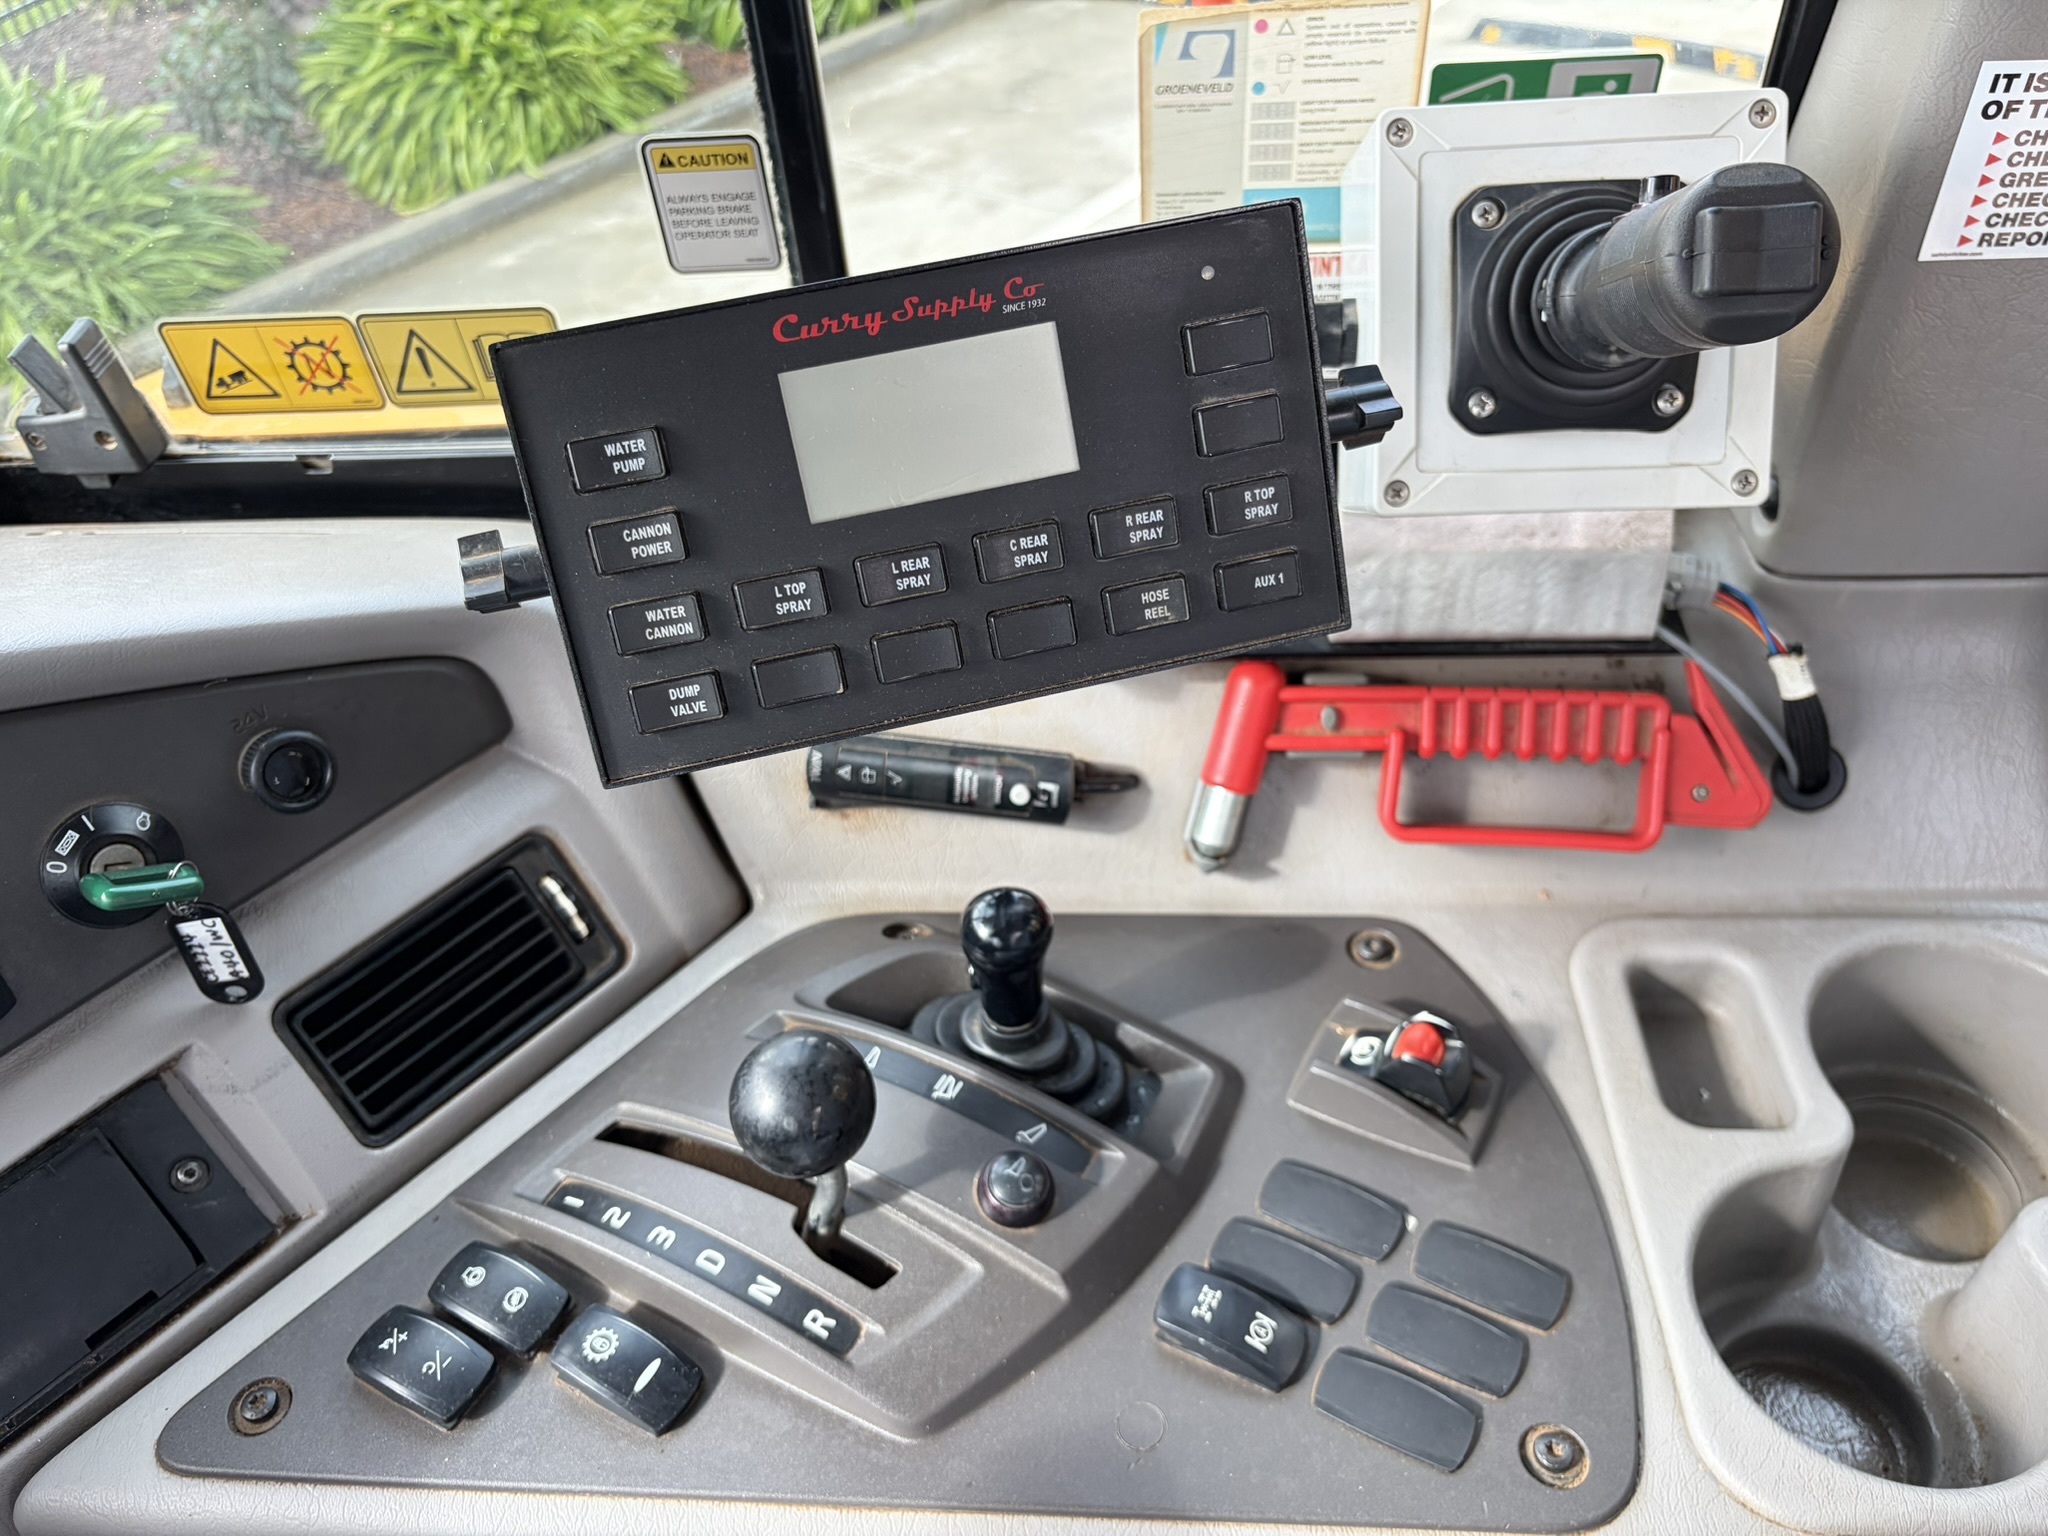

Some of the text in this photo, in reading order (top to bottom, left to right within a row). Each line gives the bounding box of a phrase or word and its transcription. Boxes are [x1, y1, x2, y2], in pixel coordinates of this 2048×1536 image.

[1155, 83, 1234, 95] GROENEVELD
[1989, 72, 2048, 93] IT IS
[1981, 99, 2048, 121] OF T
[677, 153, 749, 168] CAUTION
[666, 192, 756, 204] ALWAYS ENGAGE
[669, 204, 753, 217] PARKING BRAKE
[672, 216, 760, 229] BEFORE LEAVING
[675, 228, 758, 241] OPERATOR SEAT
[772, 276, 1045, 343] Curry Supply Co
[1002, 298, 1047, 314] SINCE 1932
[604, 438, 647, 457] WATER
[612, 458, 646, 474] PUMP
[1244, 487, 1276, 503] R TOP
[1125, 510, 1164, 527] R REAR
[1244, 503, 1280, 520] SPRAY
[623, 522, 673, 543] CANNON
[1129, 526, 1165, 544] SPRAY
[631, 541, 673, 559] POWER
[1010, 533, 1049, 551] C REAR
[892, 556, 930, 574] L REAR
[1014, 551, 1049, 568] SPRAY
[896, 573, 931, 591] SPRAY
[1254, 572, 1285, 589] AUX 1
[774, 582, 807, 598] L TOP
[1141, 588, 1170, 604] HOSE
[645, 605, 686, 623] WATER
[775, 598, 812, 615] SPRAY
[1144, 605, 1171, 620] REEL
[645, 622, 694, 640] CANNON
[668, 684, 701, 701] DUMP
[670, 700, 708, 718] VALVE
[600, 1206, 632, 1230] 2
[646, 1225, 677, 1251] 3
[694, 1248, 726, 1276] D
[747, 1274, 782, 1307] N
[802, 1308, 838, 1341] R
